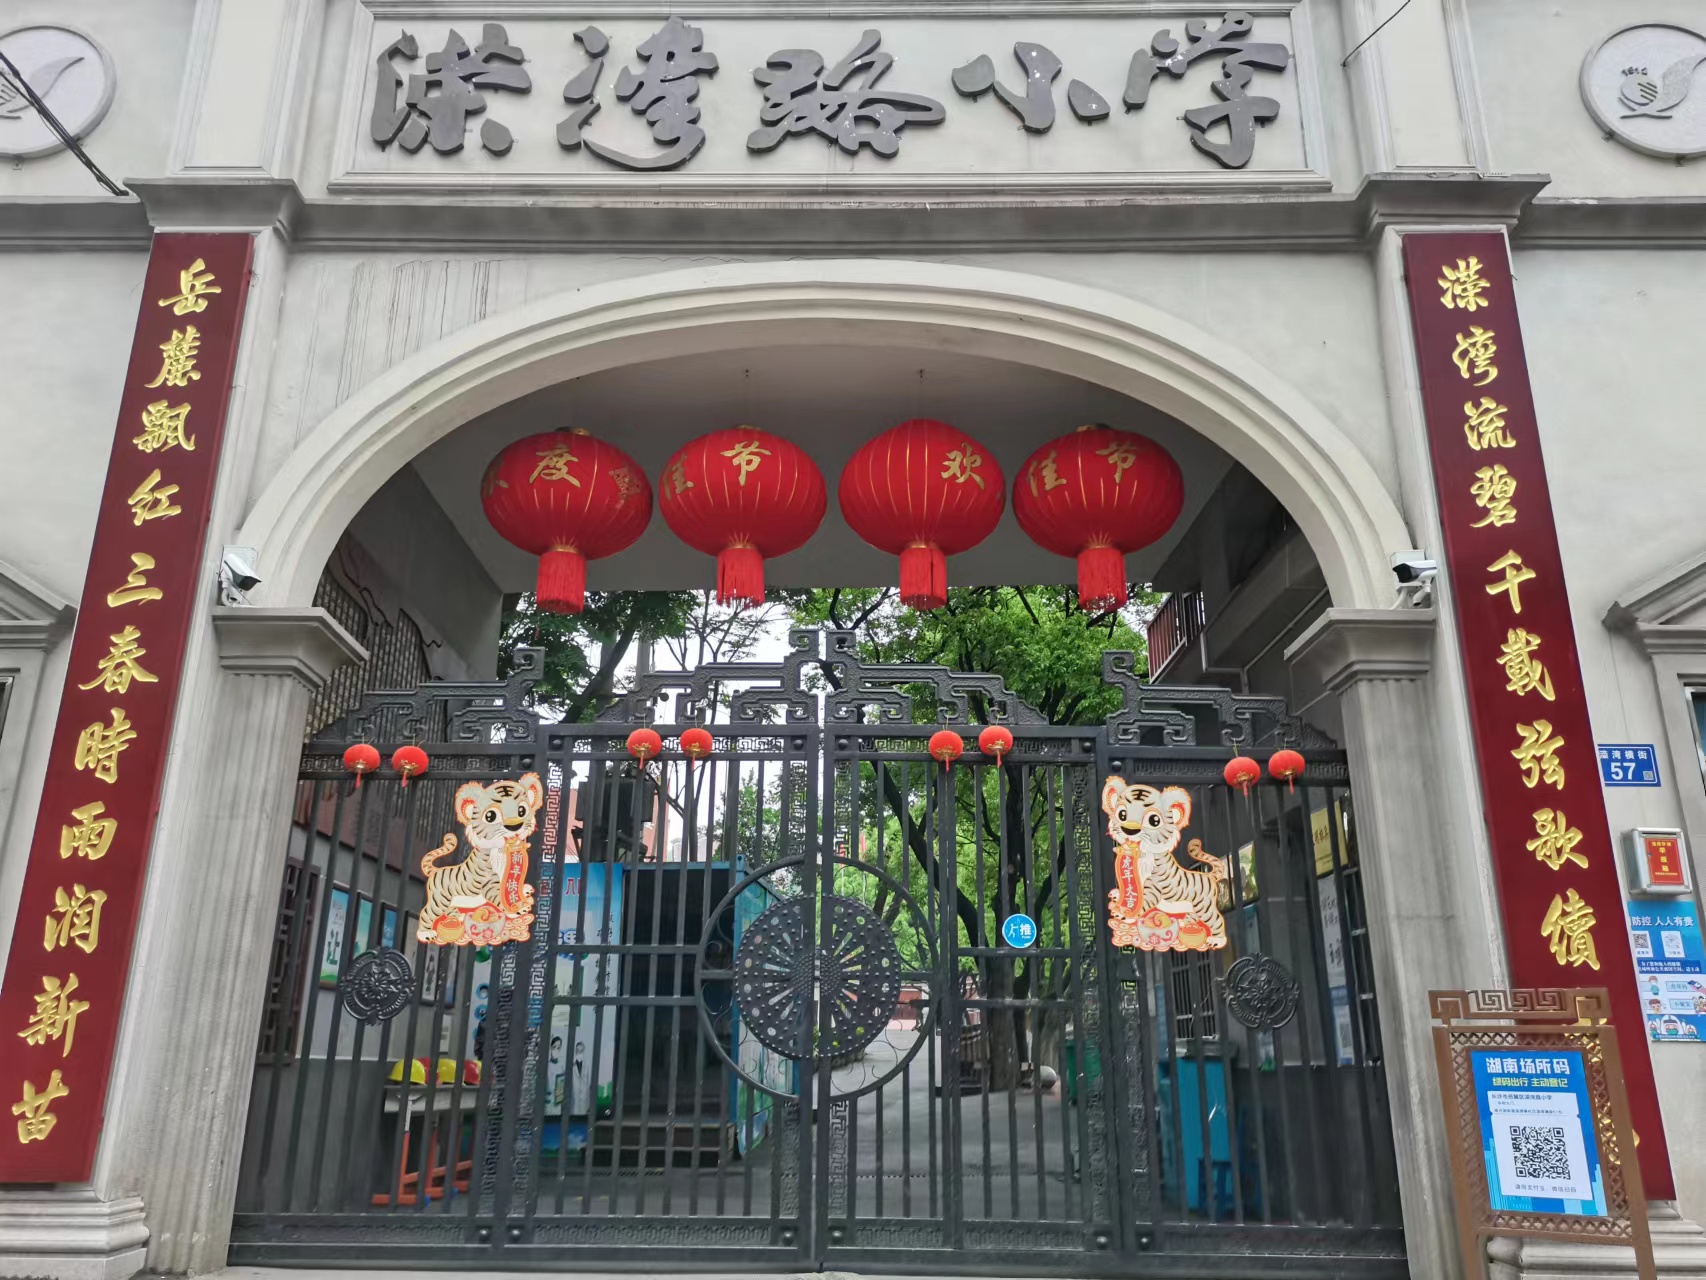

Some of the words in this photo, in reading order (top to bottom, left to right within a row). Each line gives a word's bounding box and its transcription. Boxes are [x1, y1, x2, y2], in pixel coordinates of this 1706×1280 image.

[1610, 762, 1636, 781] 57
[506, 852, 523, 905] 新年快乐
[1121, 855, 1138, 909] 虎年大吉
[1020, 923, 1032, 936] 推
[1485, 1057, 1571, 1075] 湖南场所码
[1531, 1078, 1568, 1088] 主动登记
